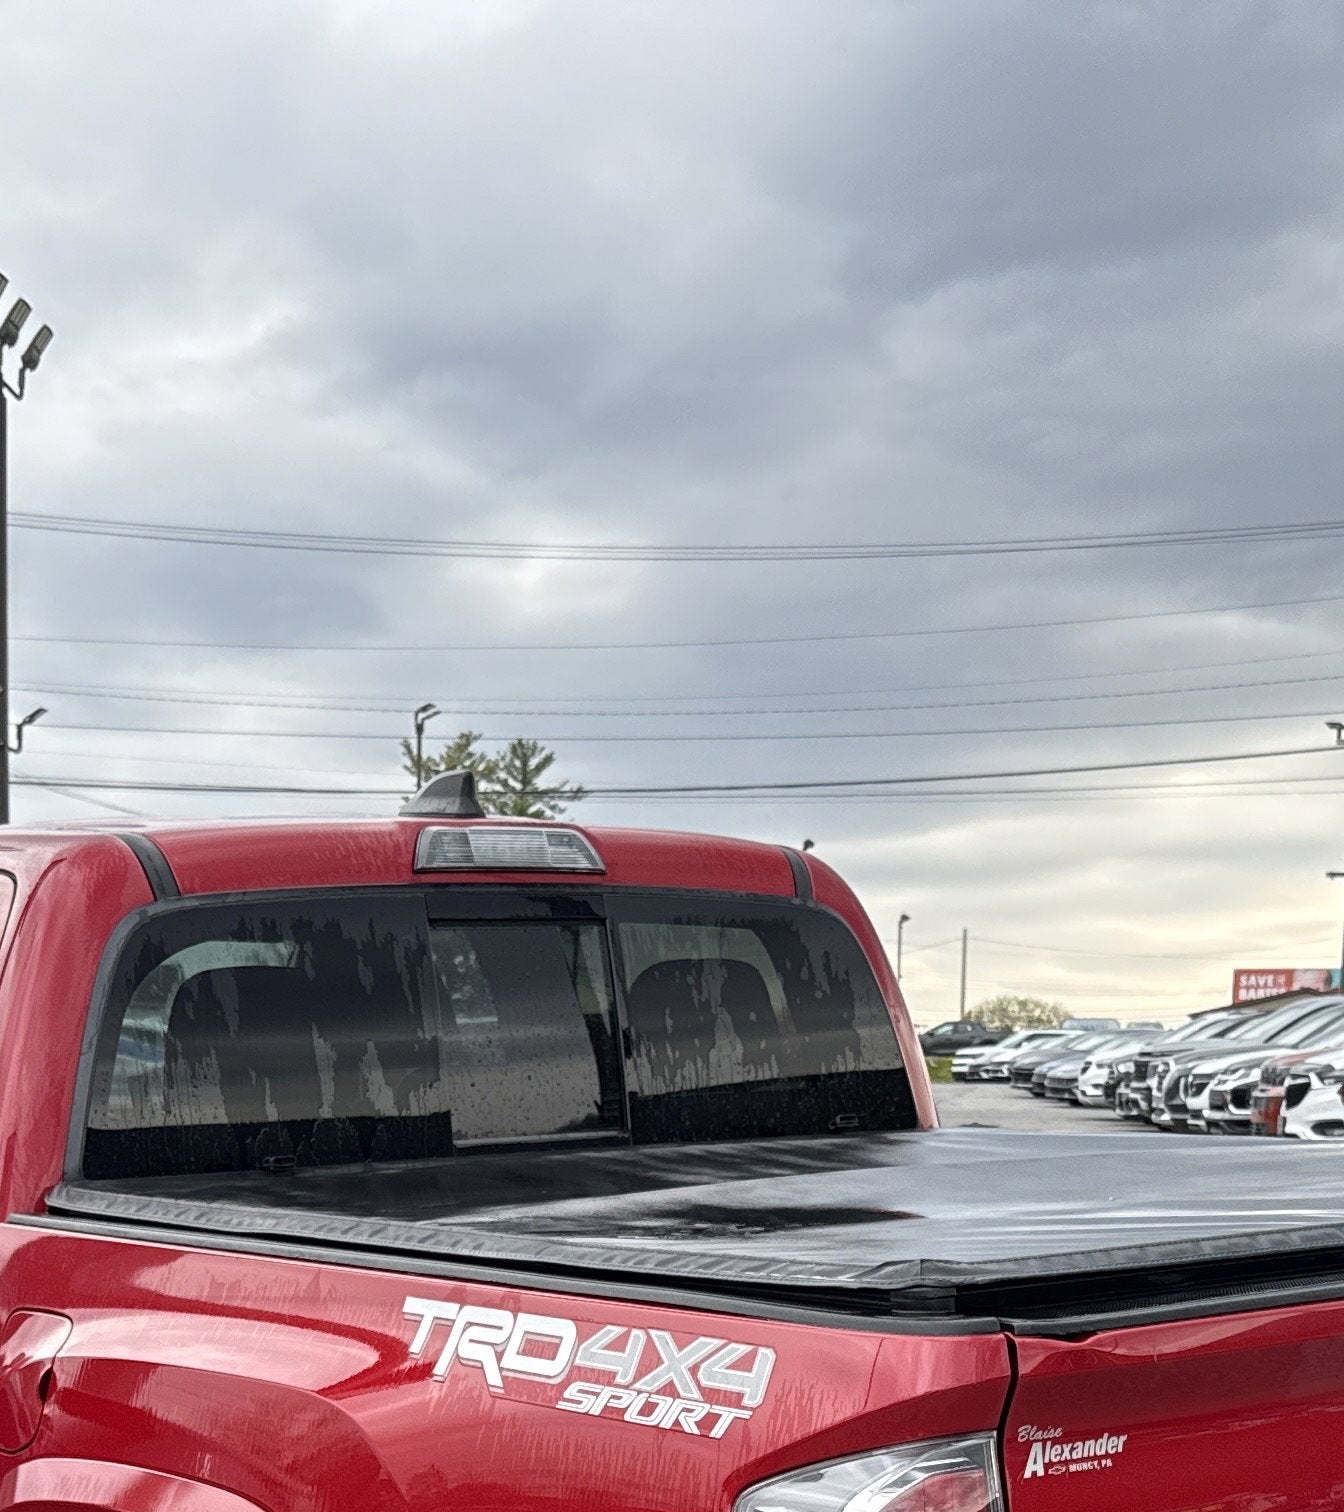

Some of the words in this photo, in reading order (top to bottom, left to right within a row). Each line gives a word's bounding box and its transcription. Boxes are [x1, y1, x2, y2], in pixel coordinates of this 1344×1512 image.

[1239, 974, 1274, 987] SAVE
[401, 1296, 578, 1398] TRD
[557, 1381, 754, 1440] SPORT
[1017, 1424, 1063, 1443] Blaise
[1023, 1433, 1128, 1479] Alexander
